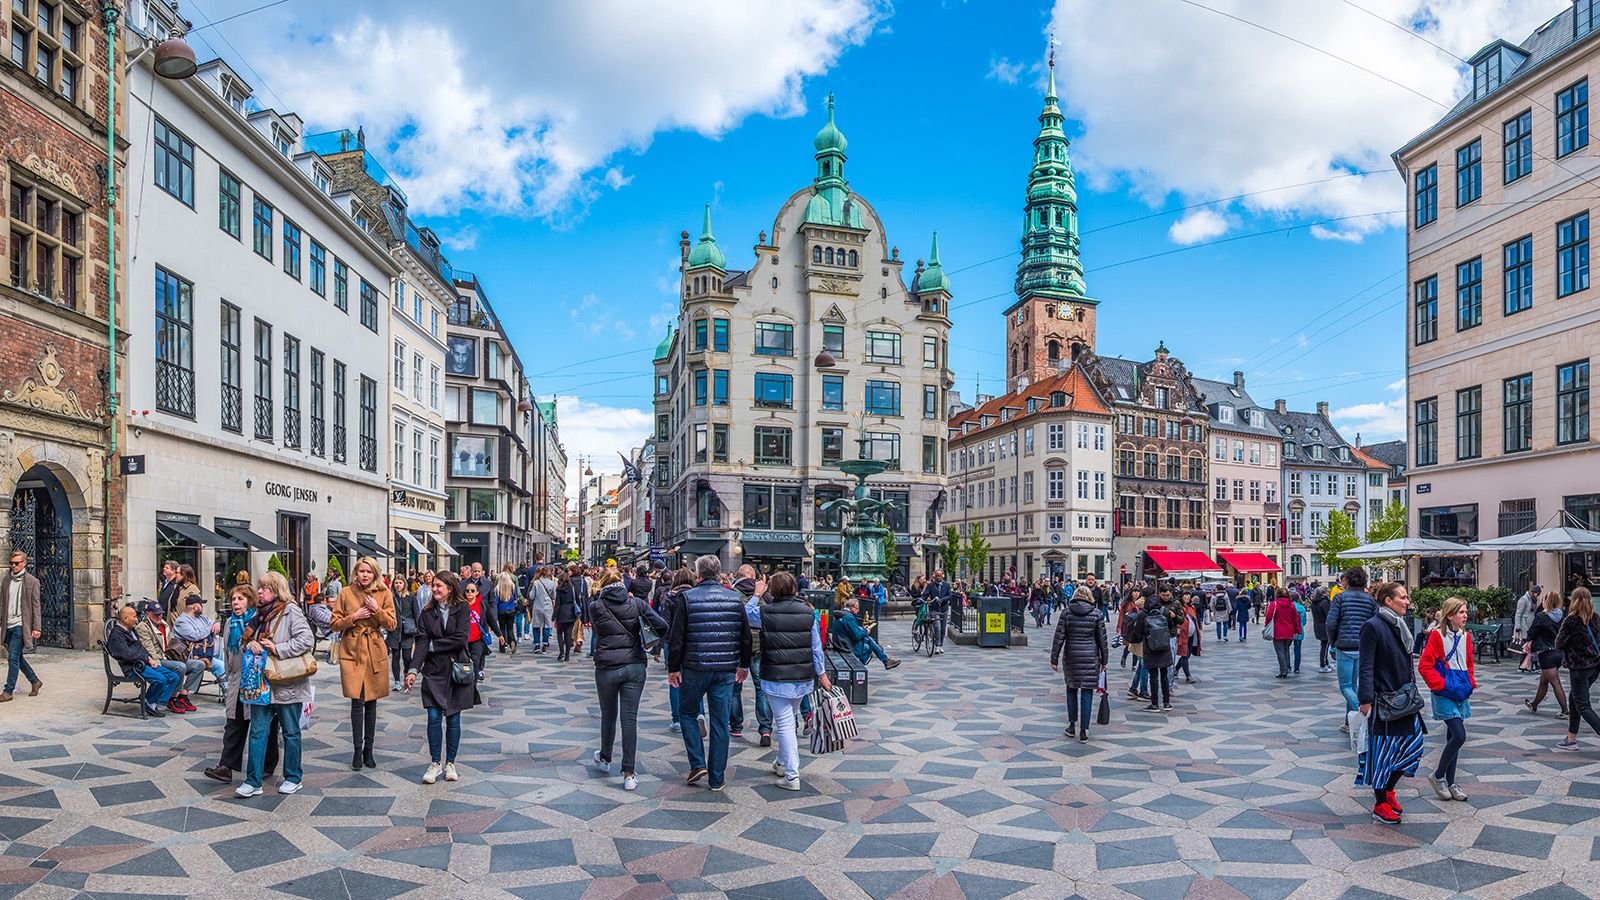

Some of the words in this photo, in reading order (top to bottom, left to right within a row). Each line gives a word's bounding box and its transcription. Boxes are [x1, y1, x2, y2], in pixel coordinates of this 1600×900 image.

[625, 465, 636, 481] HAY
[265, 481, 292, 498] GEORG
[293, 487, 318, 502] JENSEN
